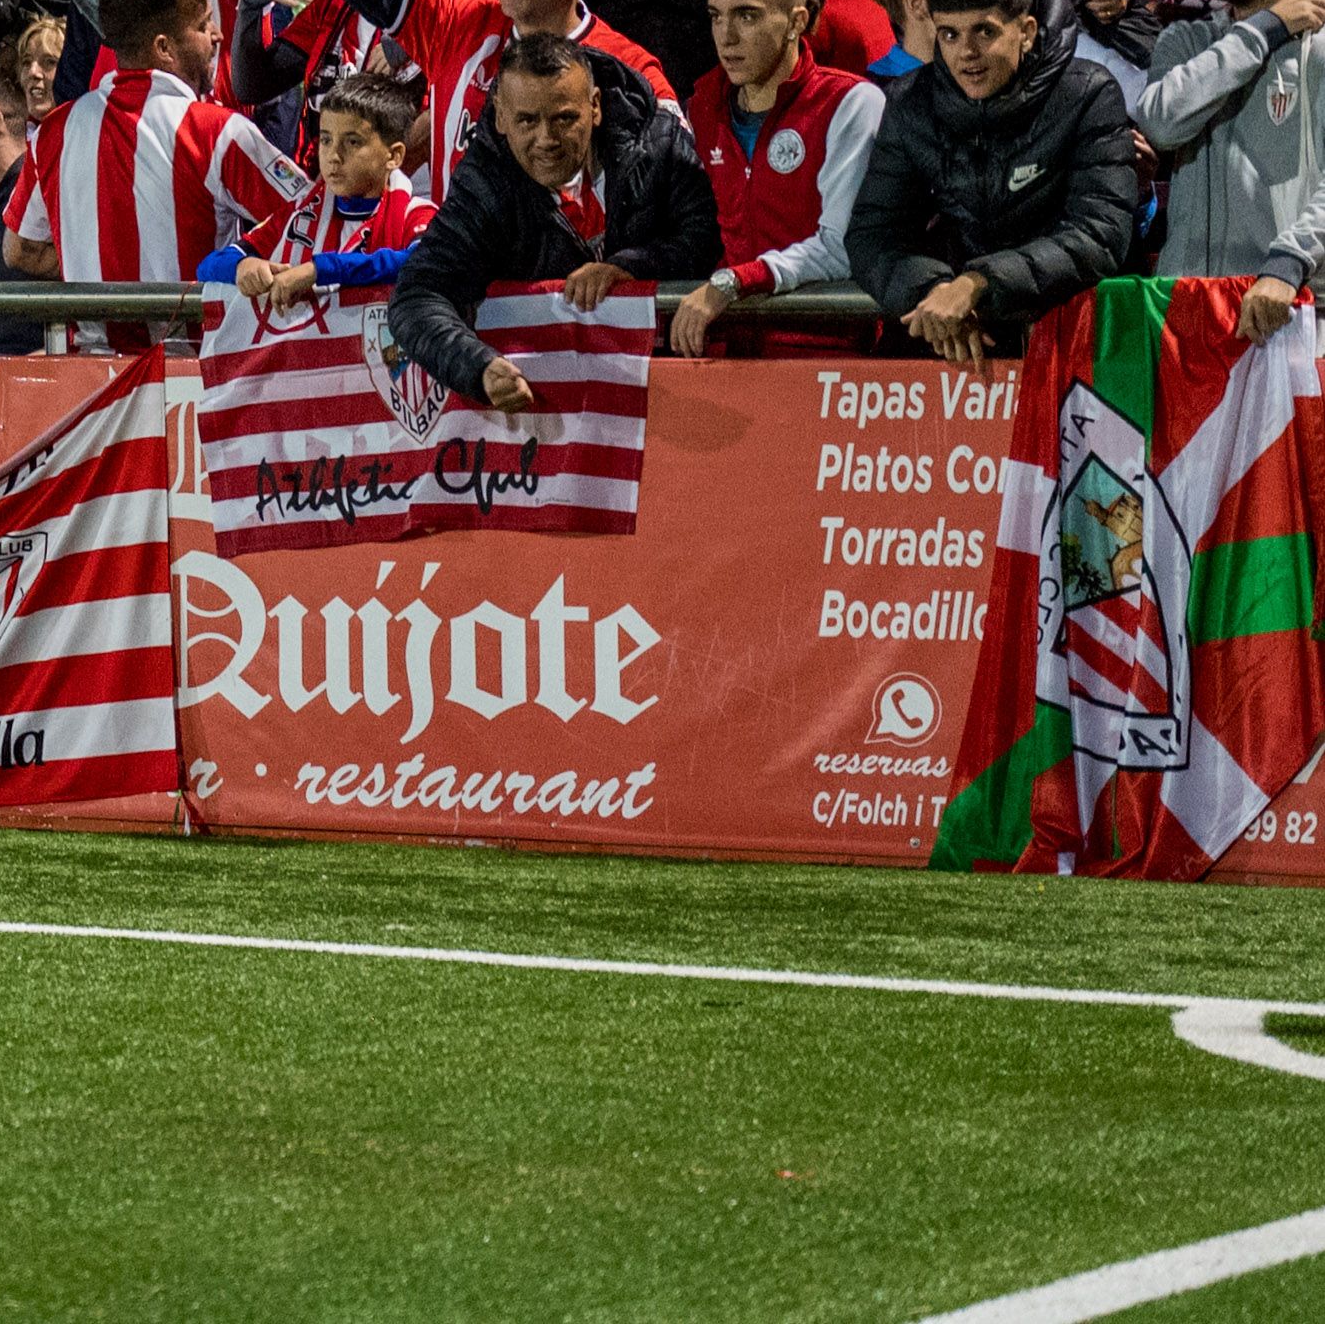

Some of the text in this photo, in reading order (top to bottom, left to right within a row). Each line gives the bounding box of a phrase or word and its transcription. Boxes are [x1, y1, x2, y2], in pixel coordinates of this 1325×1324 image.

[1013, 164, 1039, 180] NIKE
[367, 309, 389, 322] ATH
[389, 381, 446, 437] BILBAO
[817, 371, 926, 428] Tapas
[253, 435, 541, 526] Athletic Club
[815, 443, 938, 495] Platos
[819, 516, 985, 570] Torradas
[293, 752, 658, 819] restaurant
[812, 752, 952, 778] reservas
[812, 790, 908, 828] C/Folch
[915, 793, 924, 827] i
[1283, 809, 1319, 845] 82
